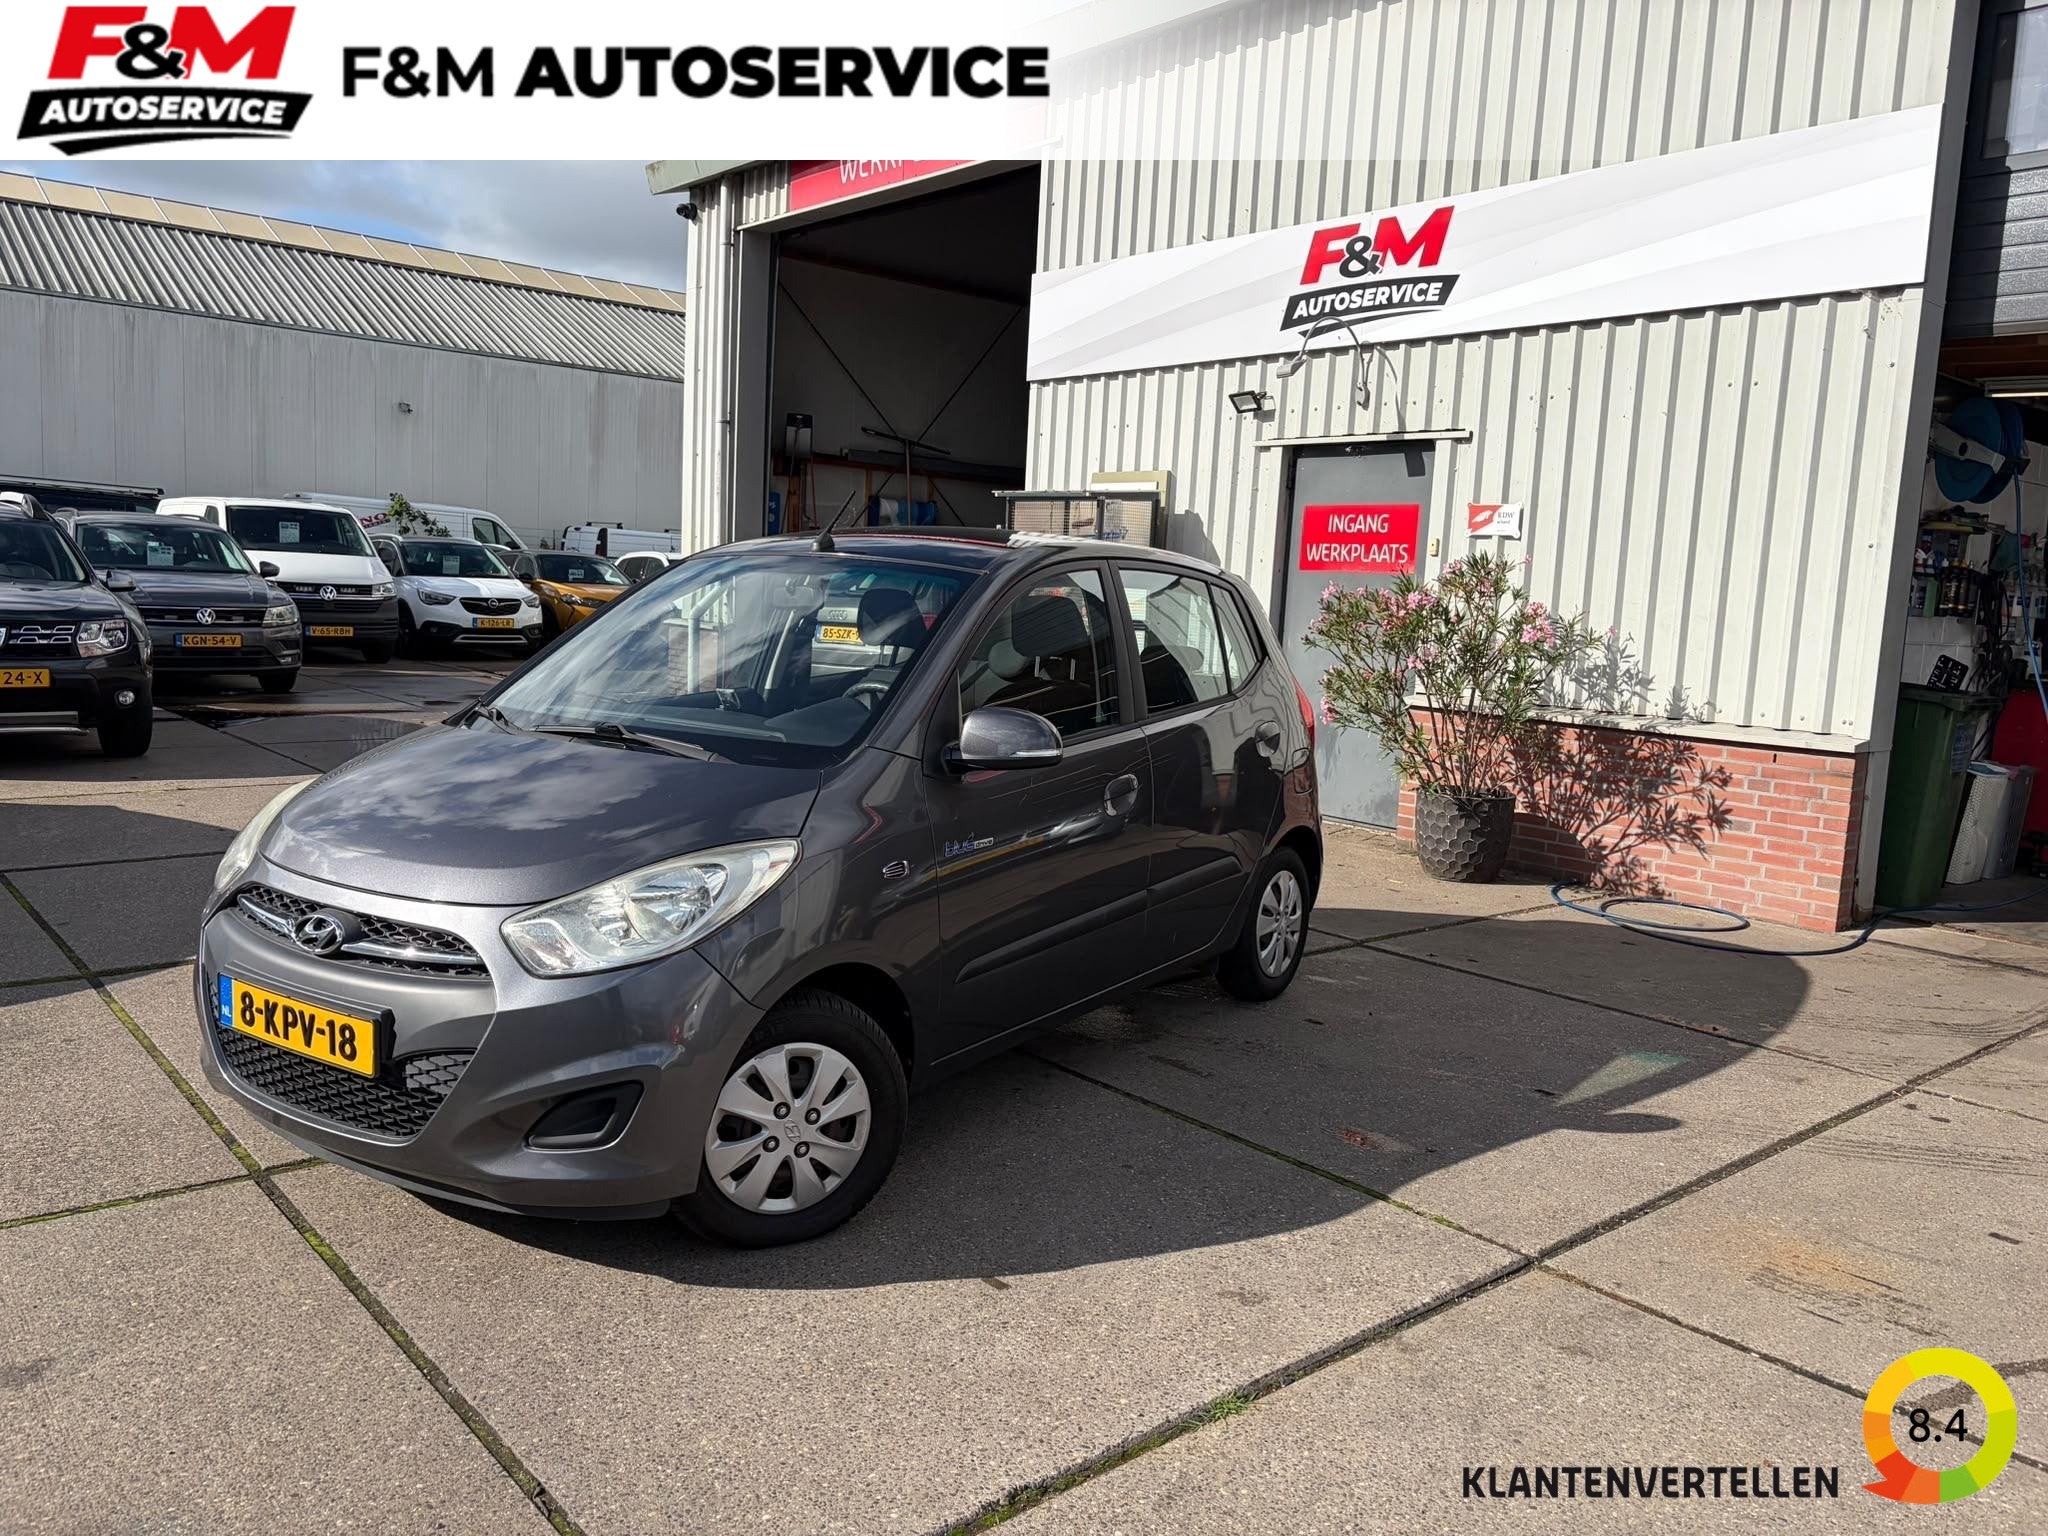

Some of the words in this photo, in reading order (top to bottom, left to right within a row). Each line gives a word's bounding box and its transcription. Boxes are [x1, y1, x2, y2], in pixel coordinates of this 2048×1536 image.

[1300, 205, 1455, 286] F&M
[1292, 282, 1443, 320] AUTOSERVICE
[1327, 513, 1390, 534] INGANG
[1306, 542, 1409, 564] WERKPLAATS
[183, 635, 237, 646] KGN-54-V
[240, 990, 358, 1063] 8-KPV-18
